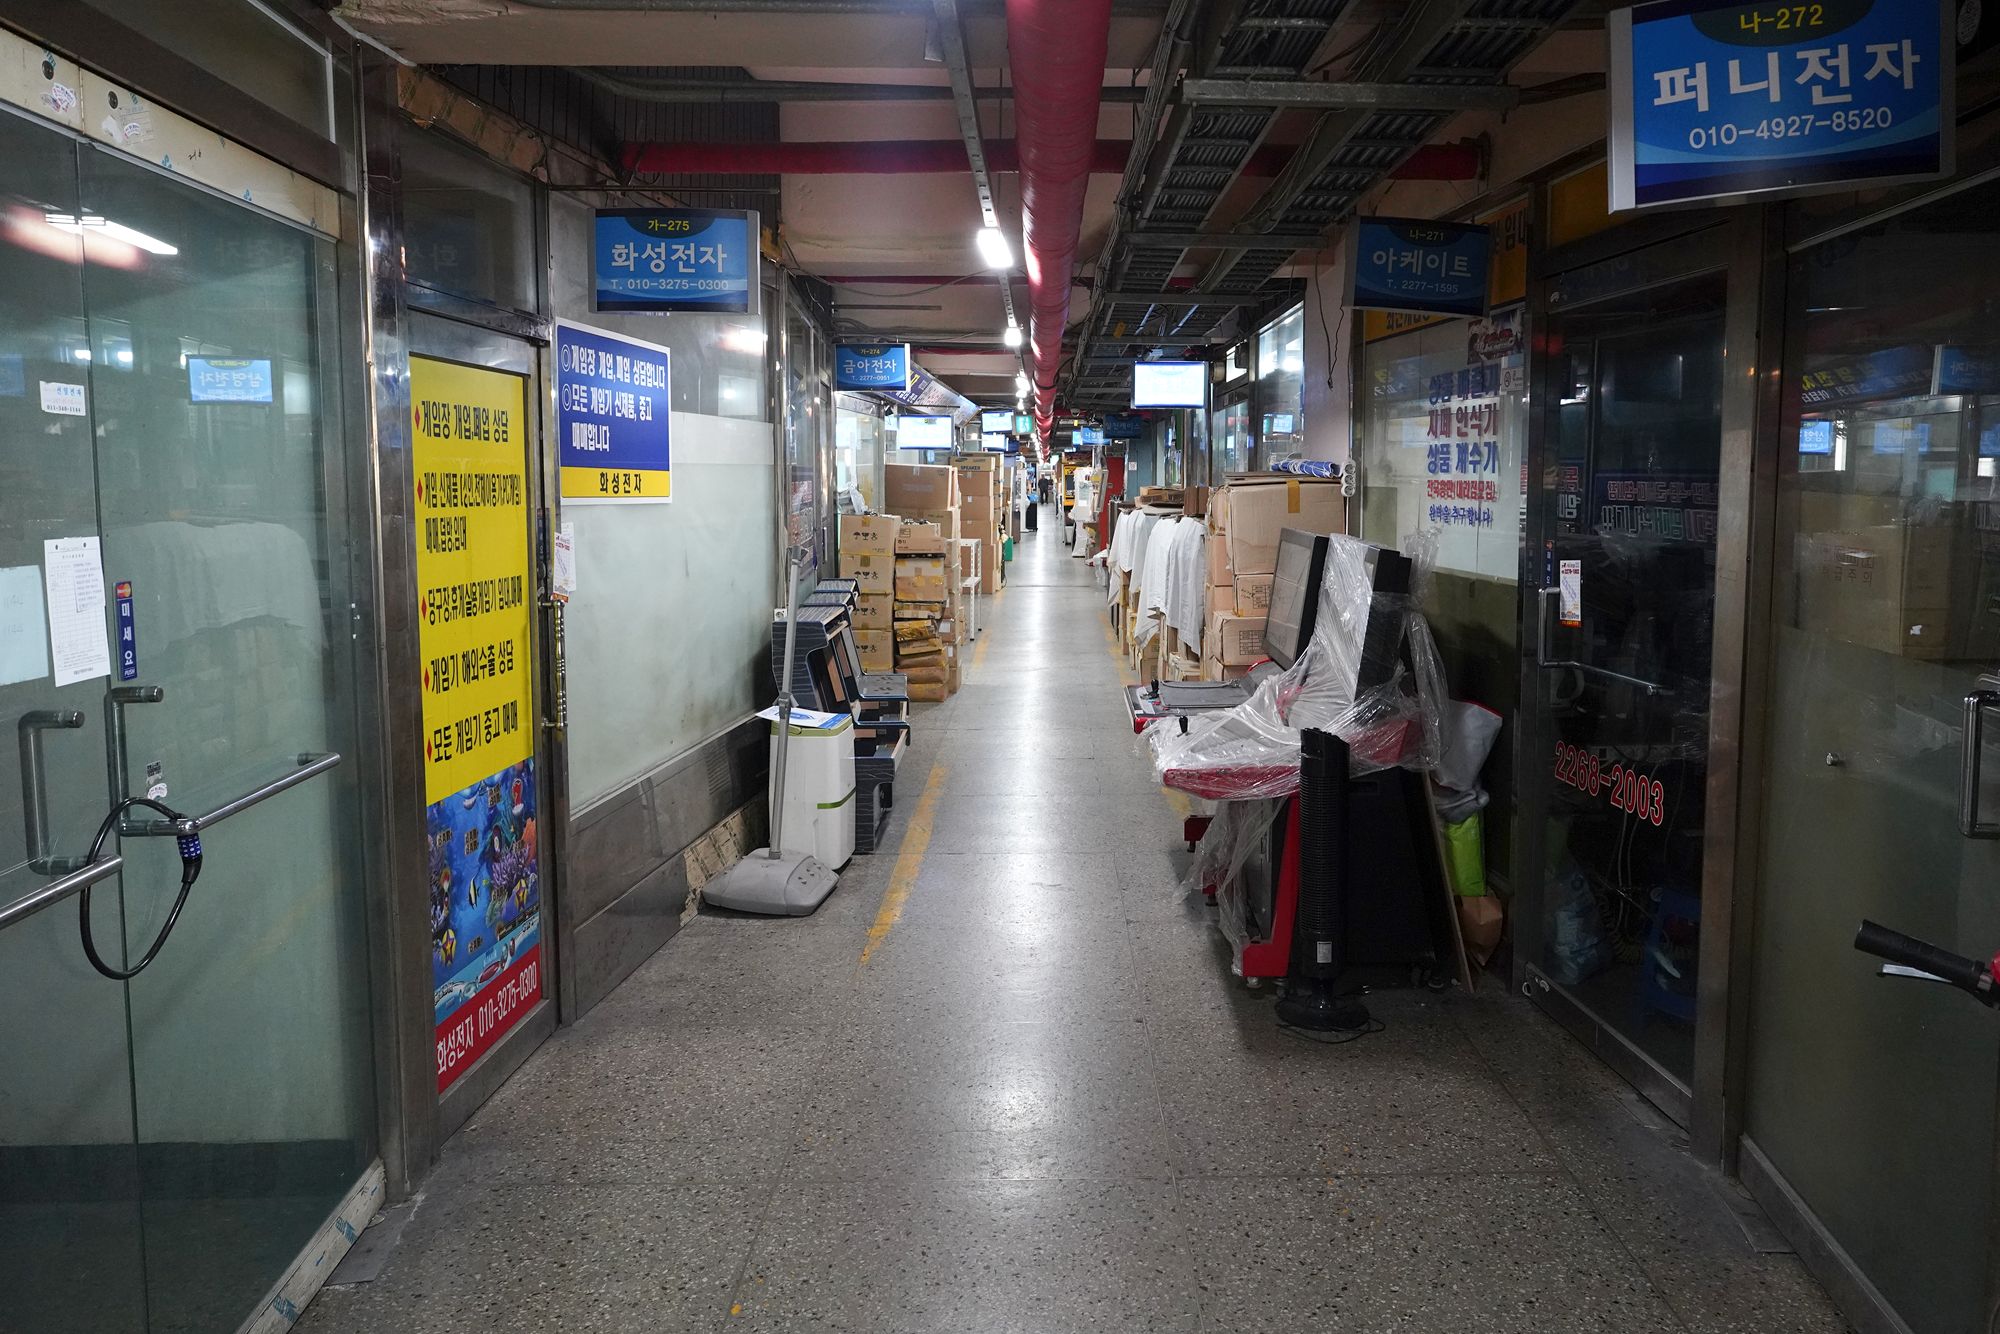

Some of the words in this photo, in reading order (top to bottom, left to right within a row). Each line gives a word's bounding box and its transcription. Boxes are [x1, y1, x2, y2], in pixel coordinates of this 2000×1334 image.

[1740, 4, 1824, 34] 나-272
[1689, 106, 1892, 149] 010-4927-8520
[648, 219, 690, 232] 가-275
[1408, 229, 1445, 241] 나-271
[611, 241, 728, 274] 화성전자
[1372, 247, 1472, 279] 아케이트
[627, 279, 729, 290] 010-3275-0300
[571, 344, 595, 377] 게임장
[632, 358, 666, 390] 상담합니다
[843, 359, 897, 374] 금아전자
[572, 383, 588, 413] 모든
[590, 386, 612, 416] 게임기
[639, 395, 653, 421] 중고
[421, 400, 450, 440] 게임장
[493, 408, 509, 443] 상담
[571, 421, 610, 452] 매매합니다
[1427, 443, 1452, 474] 상품
[424, 472, 438, 509] 게임
[439, 472, 459, 508] 신제품
[121, 602, 134, 666] 미세요
[124, 667, 136, 677] PUSH
[431, 652, 459, 694] 게임기
[462, 643, 495, 685] 해외수출
[498, 638, 514, 674] 상담
[433, 725, 452, 763] 모든
[455, 713, 481, 755] 게임기
[484, 706, 500, 744] 중고
[502, 699, 518, 735] 매매
[1554, 740, 1664, 826] 2268-2003
[437, 1013, 474, 1075] 화성전자
[478, 960, 537, 1038] 010-3275-0300
